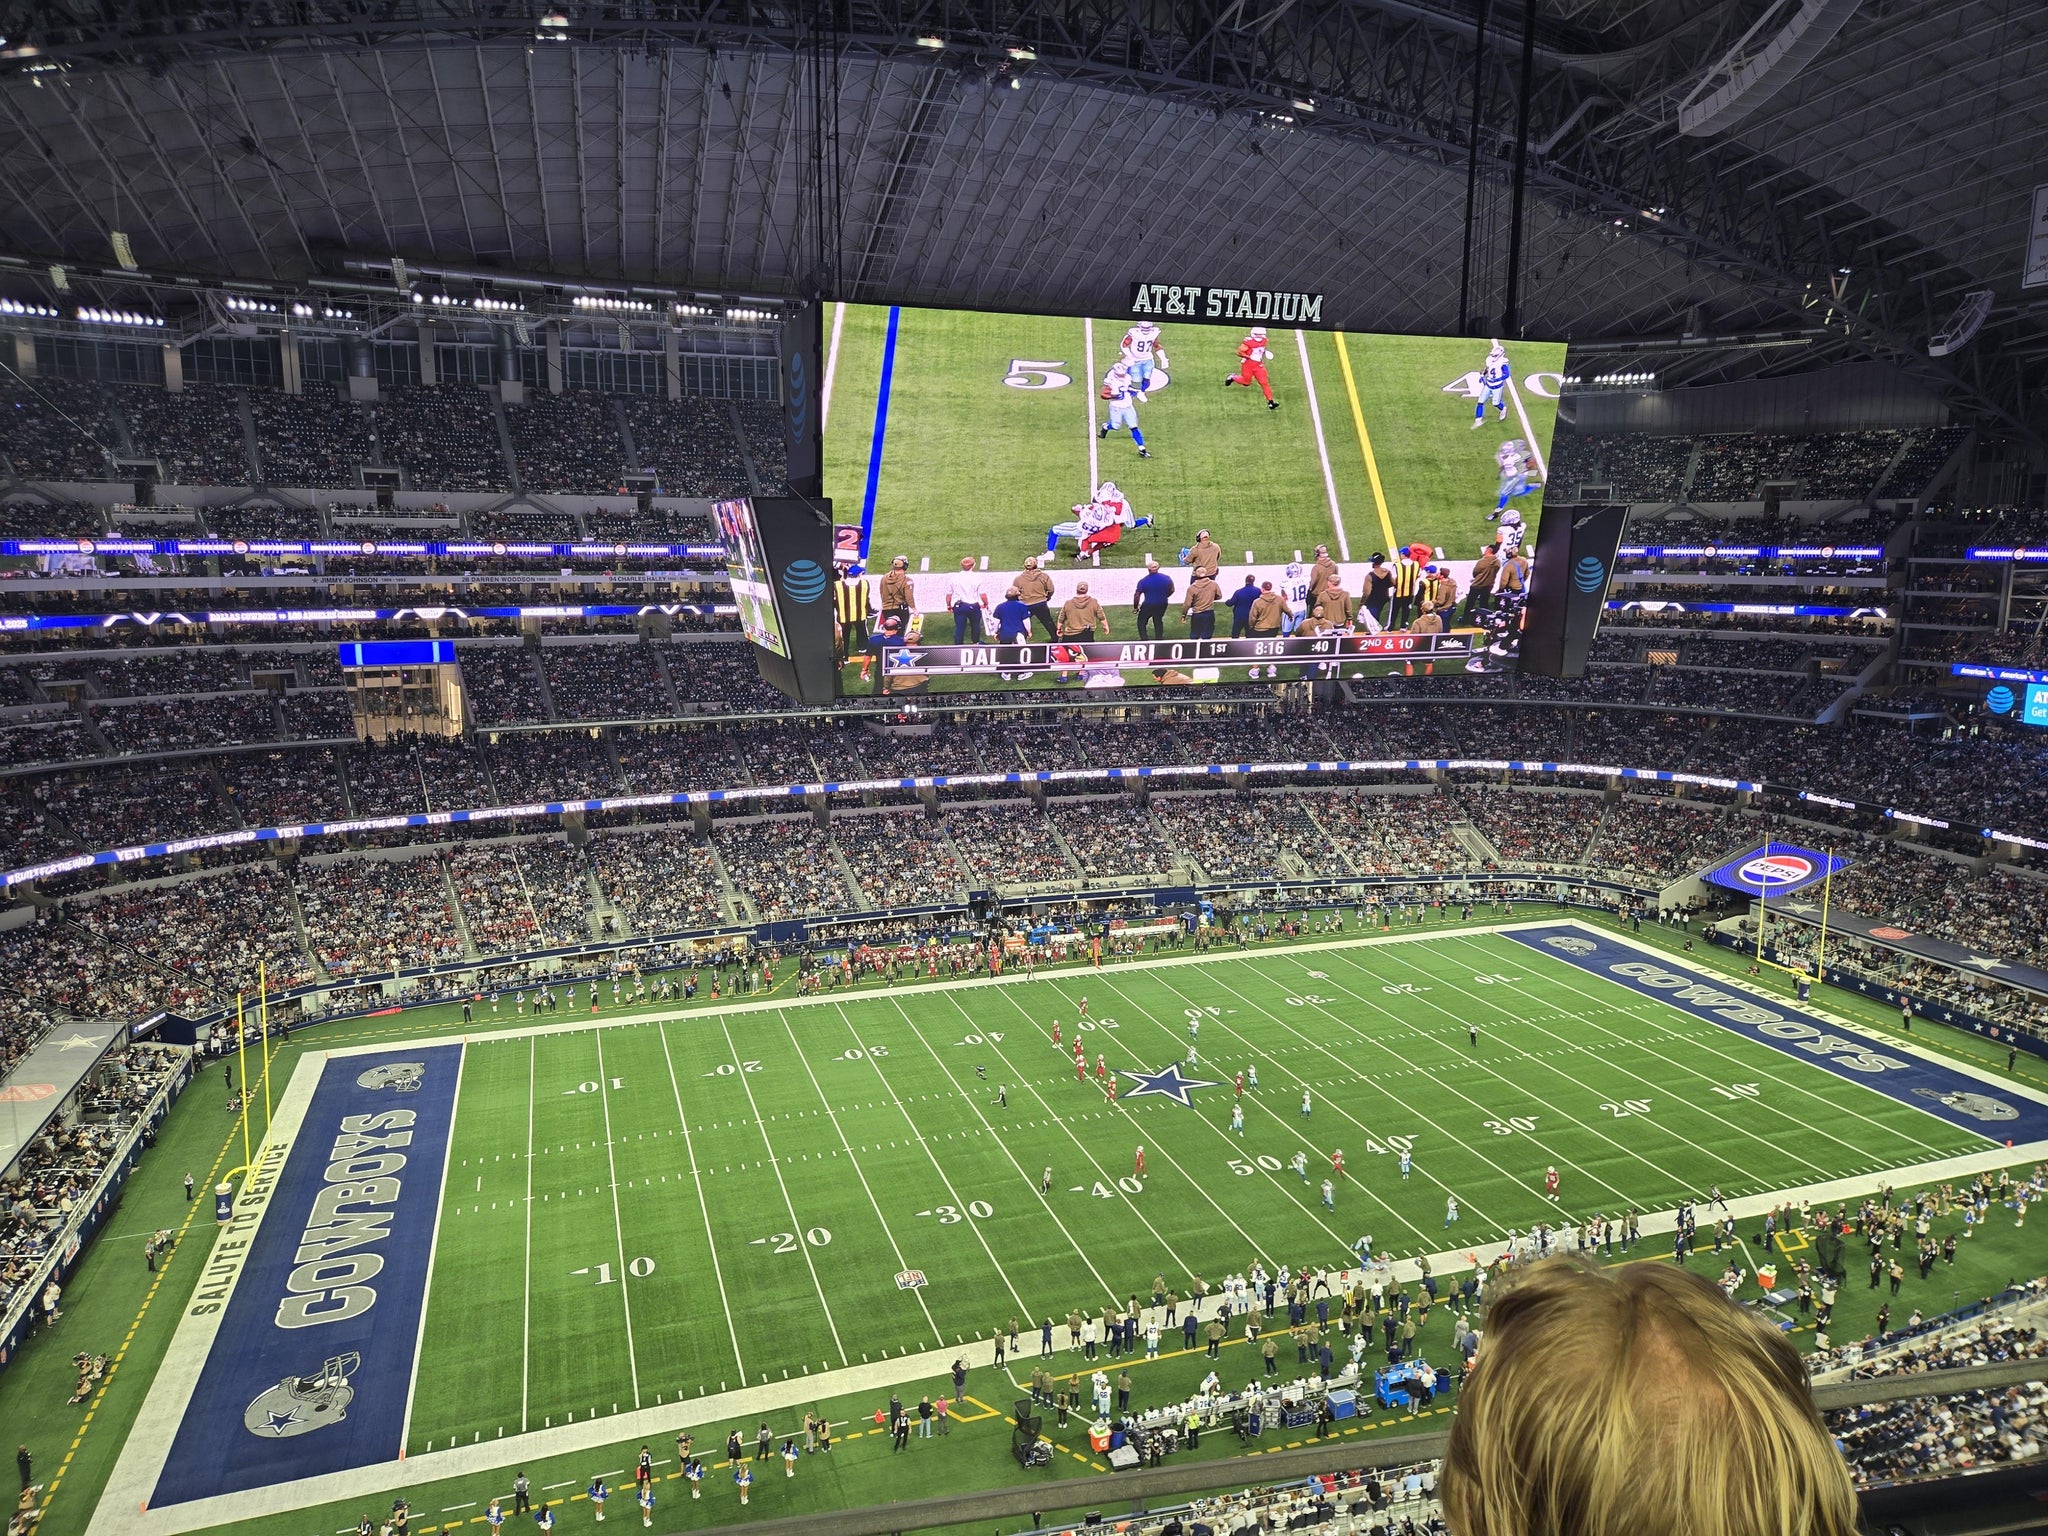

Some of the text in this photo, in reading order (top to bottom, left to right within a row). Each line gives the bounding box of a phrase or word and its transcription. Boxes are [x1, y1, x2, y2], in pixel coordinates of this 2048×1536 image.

[1132, 284, 1324, 323] AT&T STADIUM
[1137, 340, 1154, 353] 97
[837, 529, 859, 551] 2
[1506, 530, 1522, 546] 35
[1292, 584, 1307, 602] 18
[209, 613, 241, 621] DALLAS
[960, 648, 1000, 667] DAL
[1019, 647, 1032, 665] 0
[1119, 644, 1155, 662] ARI
[1170, 643, 1184, 661] 0
[1209, 642, 1228, 656] 1ST
[1255, 641, 1285, 655] 8:16
[1311, 640, 1329, 652] :40
[1359, 639, 1382, 651] 2ND
[1384, 639, 1394, 650] &
[1398, 638, 1414, 650] 10
[1960, 667, 1987, 676] American
[2000, 671, 2028, 680] American
[2031, 706, 2047, 718] Get
[688, 793, 708, 802] YETI
[1806, 793, 1856, 810] Blockchain.com
[562, 802, 585, 812] YETI
[426, 813, 451, 824] YETI
[1893, 811, 1949, 829] Blockchain.com
[276, 827, 304, 839] YETI
[116, 848, 146, 861] YETI
[1751, 861, 1800, 879] PEPSI
[1609, 962, 1911, 1073] COWBOYS
[1721, 974, 1783, 1001] TAKES
[1877, 1035, 1914, 1049] US
[961, 1030, 1006, 1045] 40
[844, 1044, 889, 1060] 30
[715, 1059, 764, 1077] 20
[578, 1076, 625, 1094] 10
[1709, 1083, 1758, 1100] 10
[1599, 1100, 1650, 1118] 20
[1483, 1116, 1536, 1136] 30
[1365, 1135, 1413, 1155] 40
[1226, 1154, 1283, 1177] 50
[1090, 1176, 1144, 1200] 40
[273, 1108, 418, 1330] COWBOYS
[935, 1200, 994, 1225] 30
[190, 1142, 289, 1317] SALUTE TO SERVICE
[770, 1227, 832, 1254] 20
[593, 1256, 656, 1286] 10
